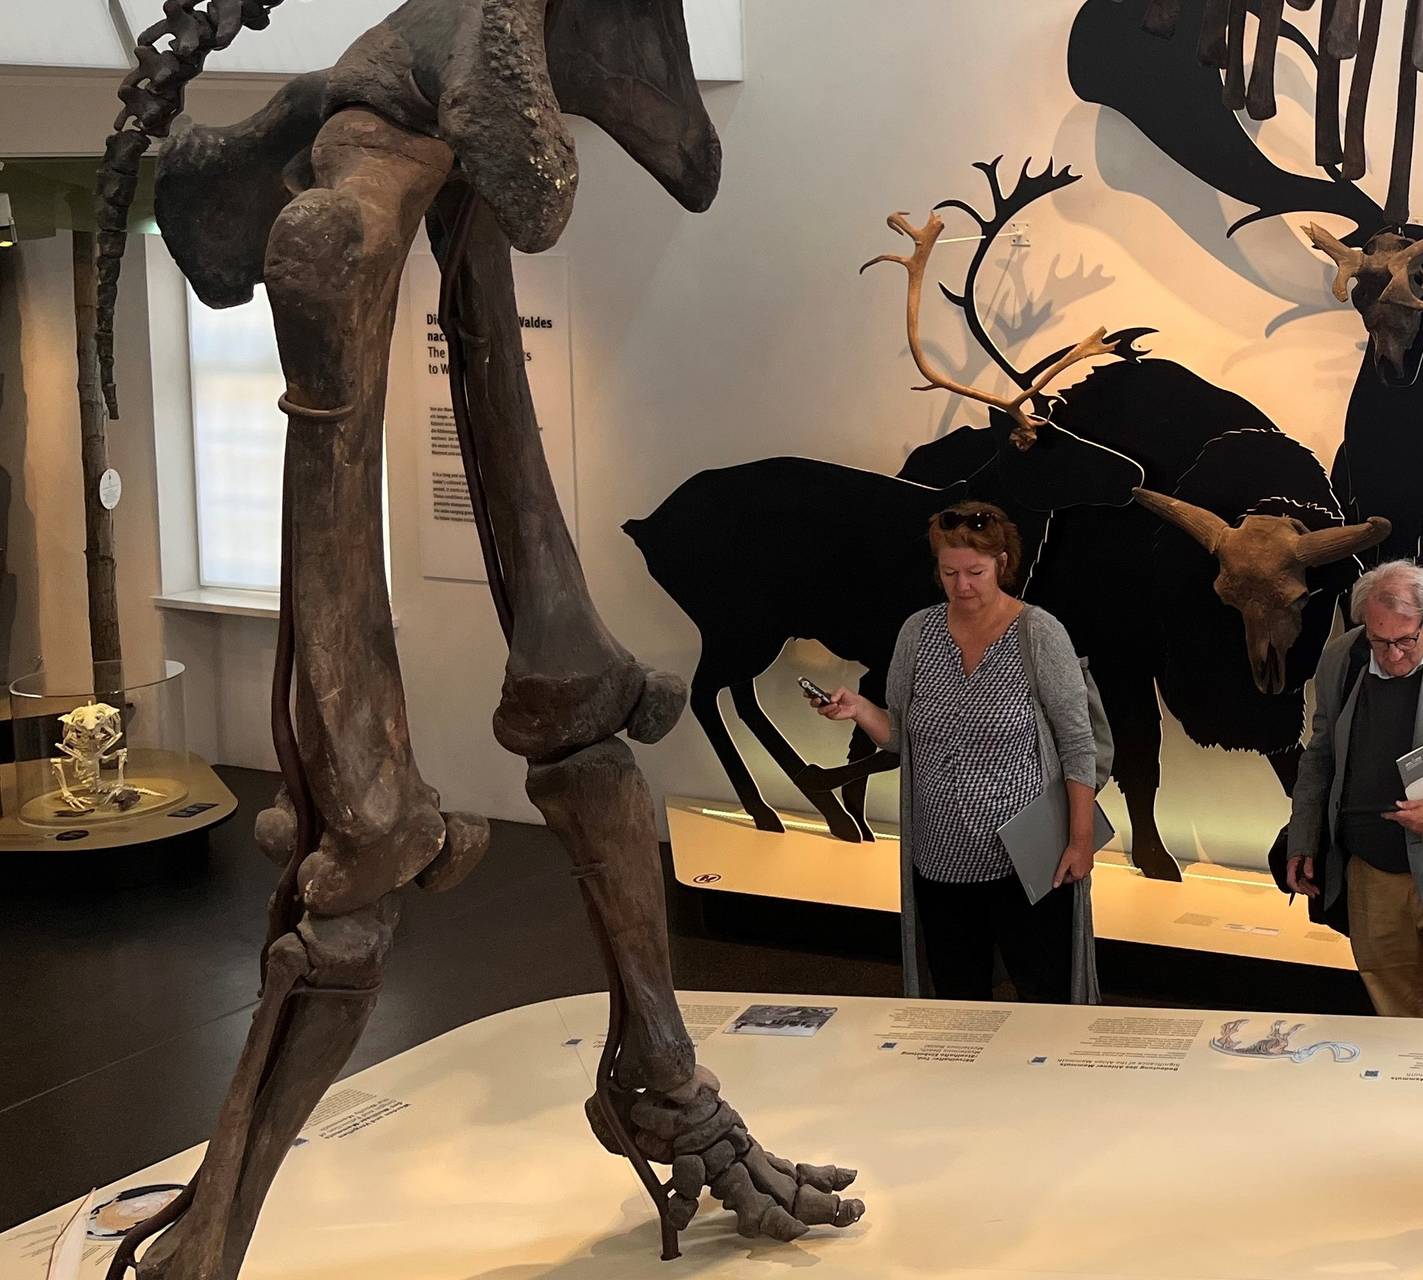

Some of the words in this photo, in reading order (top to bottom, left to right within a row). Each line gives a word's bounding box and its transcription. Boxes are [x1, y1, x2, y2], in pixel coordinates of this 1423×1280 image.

[427, 332, 447, 342] nac
[427, 346, 446, 358] The
[428, 364, 438, 374] to
